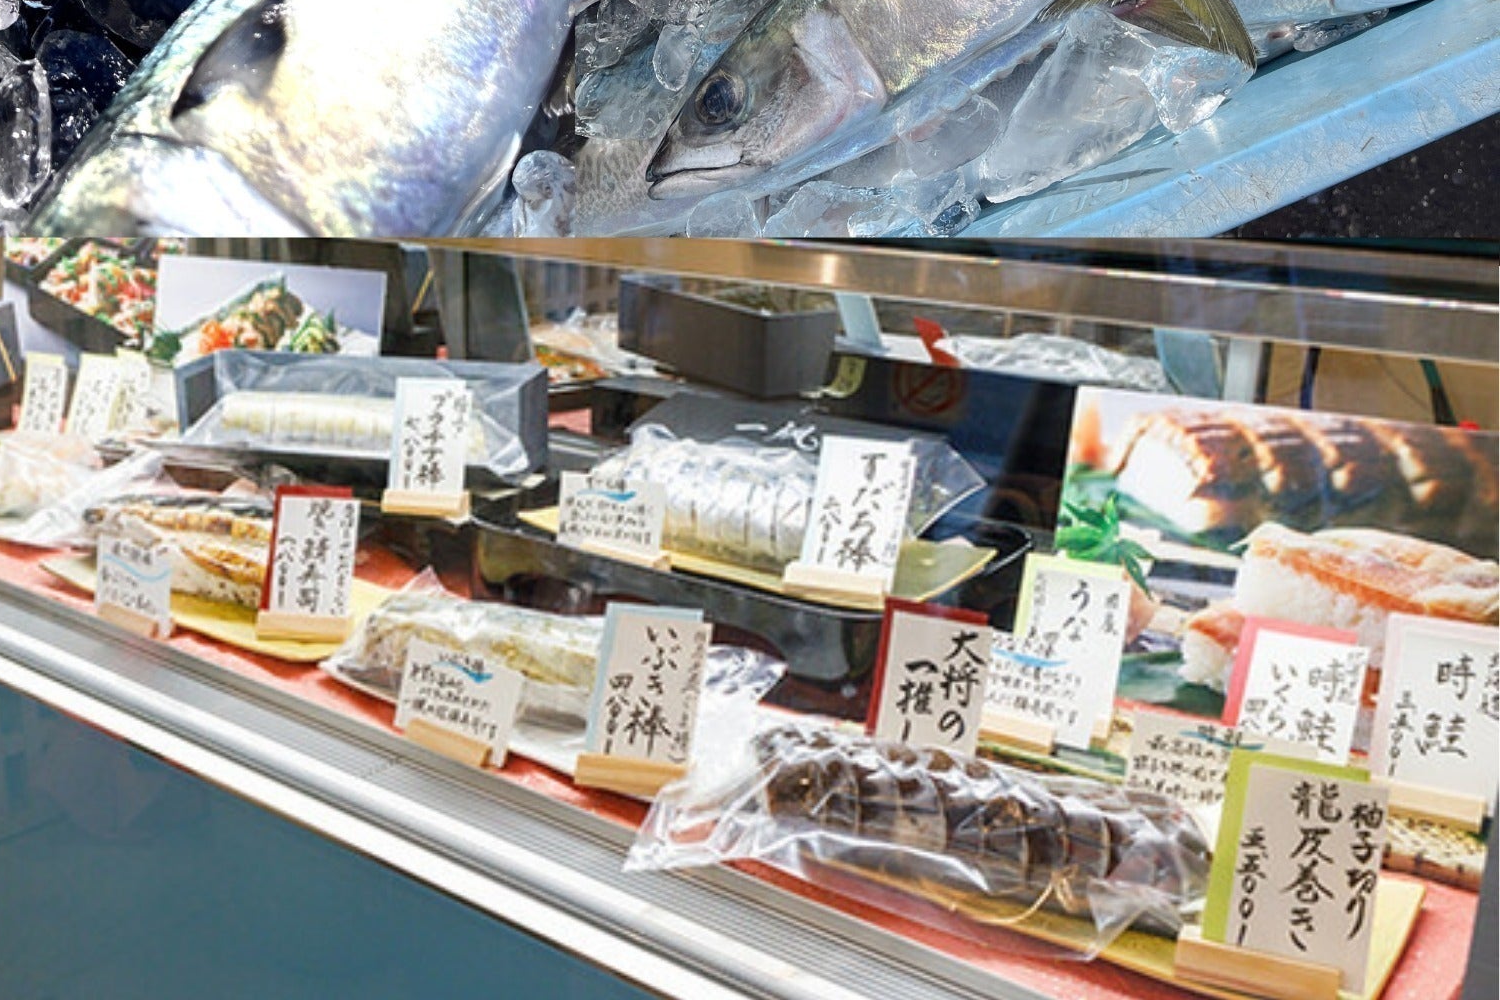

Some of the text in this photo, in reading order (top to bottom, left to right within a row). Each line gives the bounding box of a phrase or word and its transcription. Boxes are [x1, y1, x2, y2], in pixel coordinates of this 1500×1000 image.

[624, 625, 679, 757] いぶき棒
[938, 629, 987, 742] 大将の
[1414, 652, 1478, 760] 時鮭
[1345, 800, 1385, 940] 柚子切り
